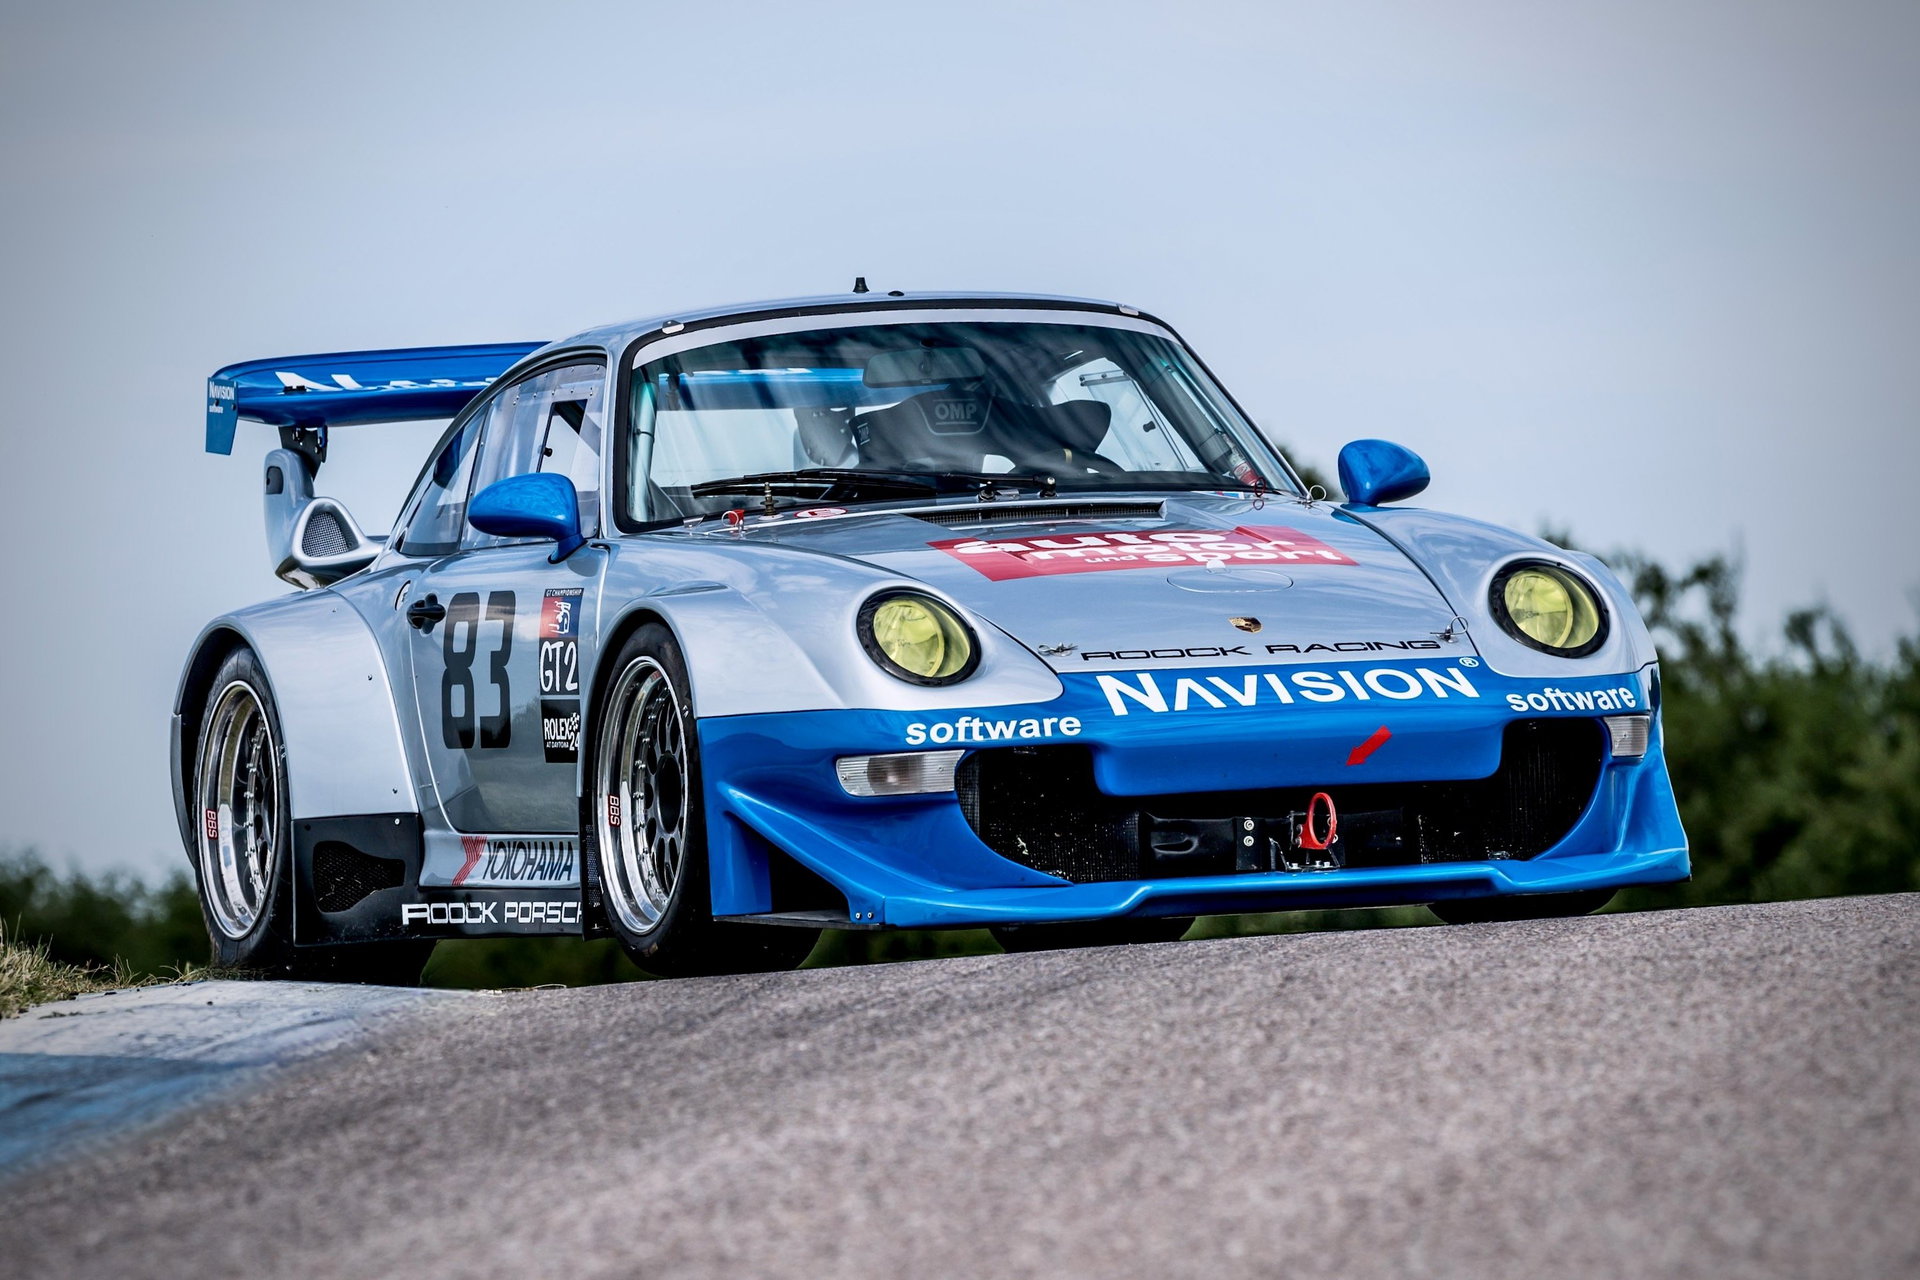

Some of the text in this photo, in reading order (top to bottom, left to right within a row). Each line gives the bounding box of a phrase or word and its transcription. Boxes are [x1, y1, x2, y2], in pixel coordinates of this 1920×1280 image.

[209, 381, 235, 400] NAVISION
[935, 402, 977, 420] OMP
[953, 532, 1227, 554] auto
[1031, 540, 1296, 560] motor
[1084, 550, 1343, 563] und sport
[1081, 640, 1442, 661] ROOCK RACING
[441, 589, 516, 749] 83
[540, 641, 578, 692] GT2
[1505, 686, 1637, 712] software
[543, 717, 580, 751] ROLEX 24
[905, 715, 1082, 745] software
[610, 795, 621, 826] BBS
[207, 810, 217, 838] BBS
[483, 841, 574, 881] YOKOHAMA
[401, 902, 498, 925] ROOCK
